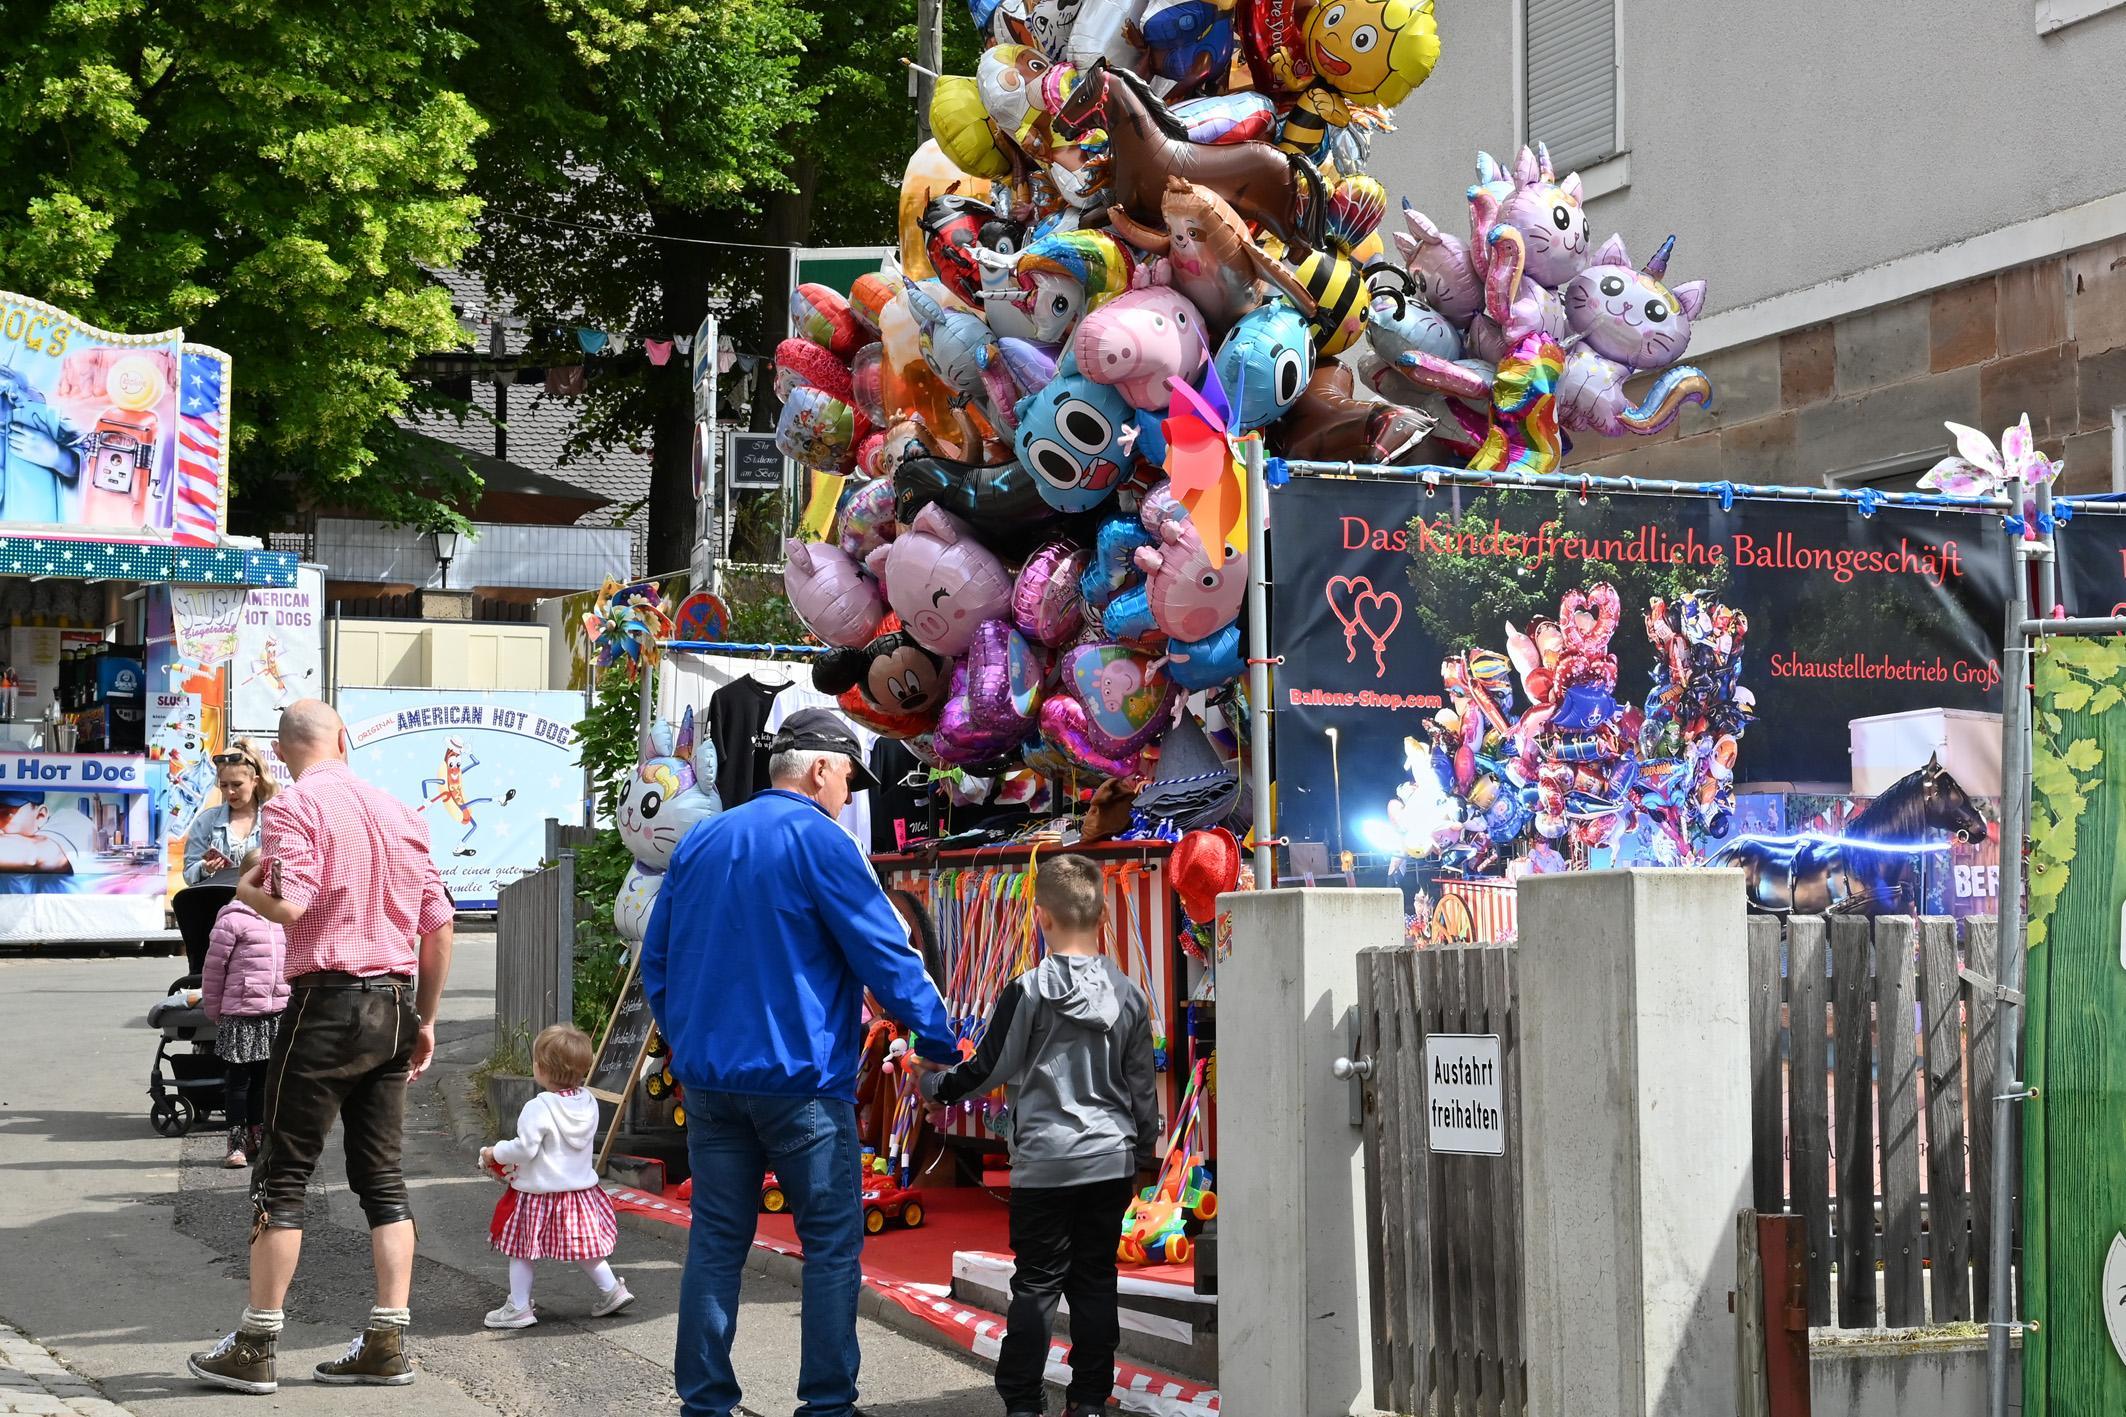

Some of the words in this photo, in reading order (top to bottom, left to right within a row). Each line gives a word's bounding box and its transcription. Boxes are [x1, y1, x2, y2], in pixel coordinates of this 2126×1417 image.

[0, 303, 71, 357] OG'S
[1339, 517, 1407, 551] Das
[1418, 519, 1723, 569] Kinderfreundliche
[1731, 532, 1964, 587] Ballongeschäft
[275, 610, 312, 626] DOGS
[1770, 653, 1949, 683] Schaustellerbetrieb
[1289, 688, 1443, 709] Ballons-Shop.com
[357, 718, 395, 742] ORIGINAL
[398, 706, 482, 731] AMERICAN
[493, 708, 528, 731] HOT
[534, 717, 570, 745] DOG
[17, 758, 71, 780] HOT
[82, 760, 136, 781] DOG
[909, 821, 929, 833] Mei
[462, 867, 491, 876] einen
[1434, 1055, 1493, 1086] Ausfahrt
[1431, 1098, 1498, 1131] freihalten
